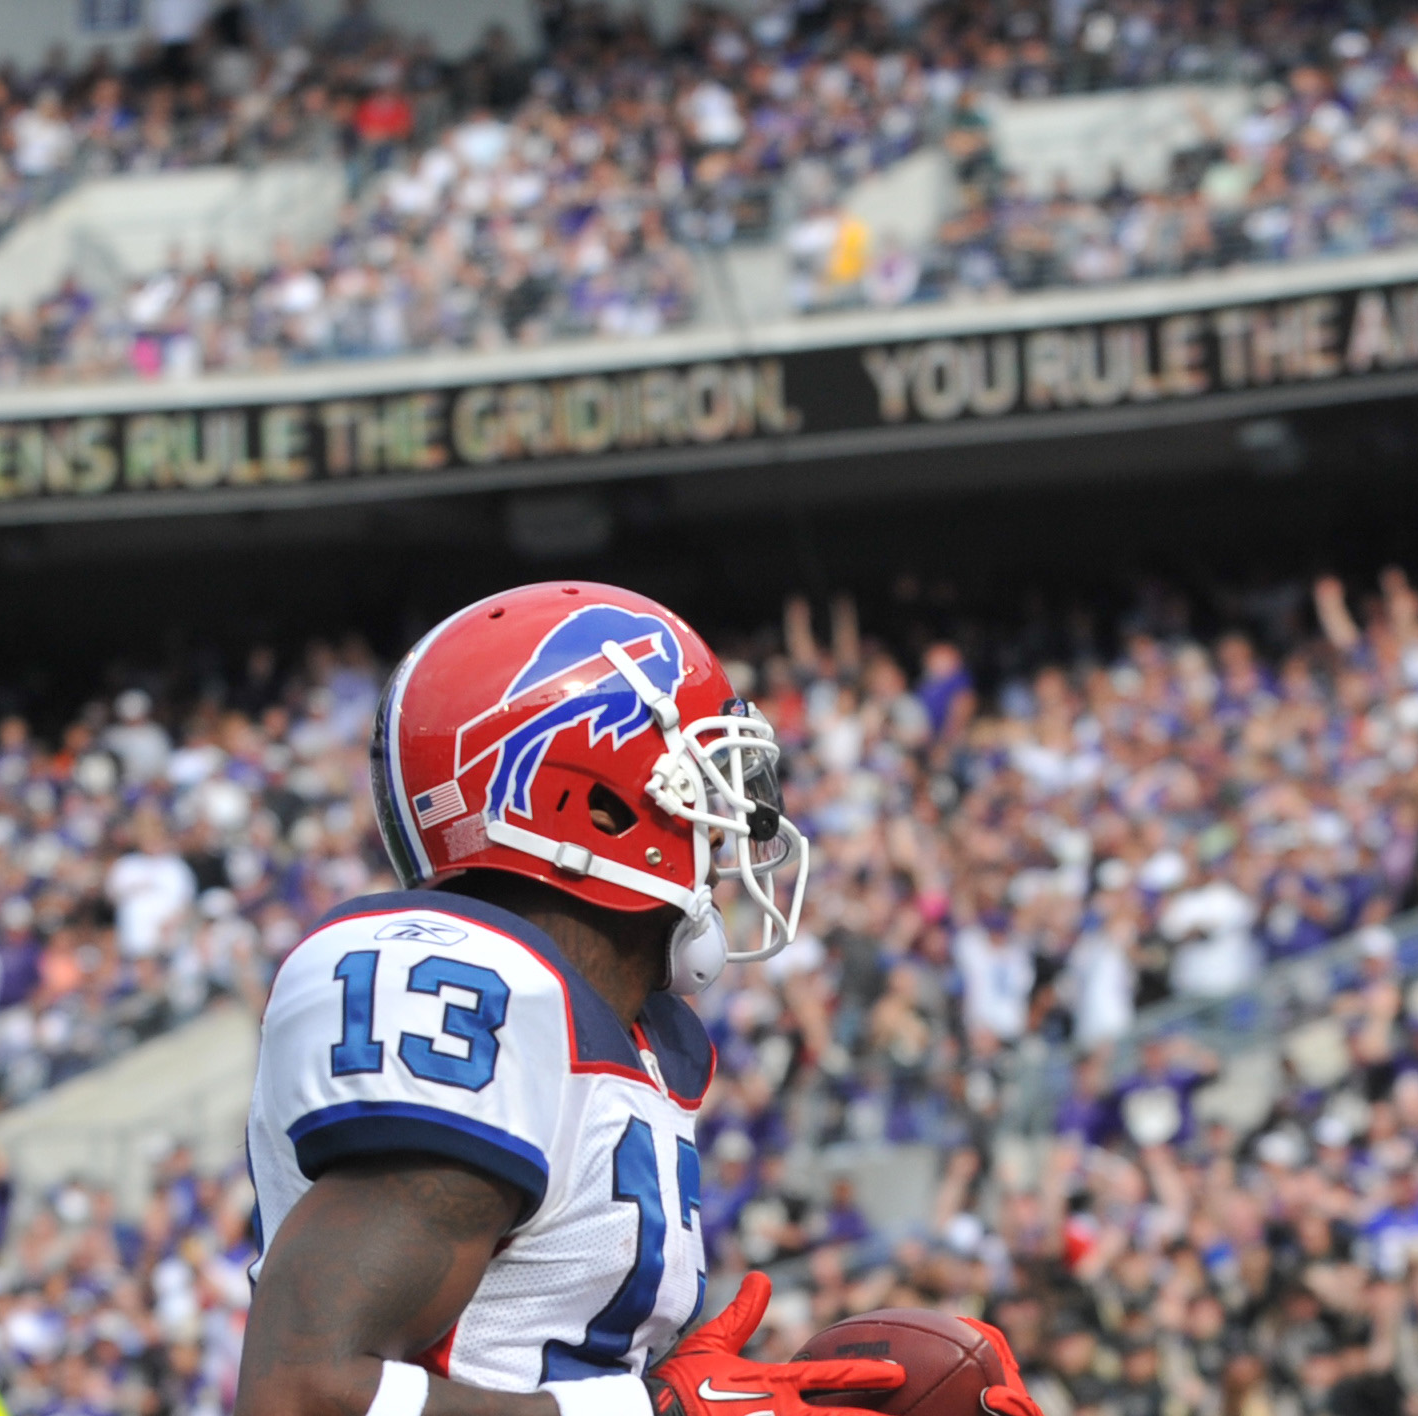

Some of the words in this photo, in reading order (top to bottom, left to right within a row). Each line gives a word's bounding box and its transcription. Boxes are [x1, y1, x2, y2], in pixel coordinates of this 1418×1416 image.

[861, 333, 1019, 420] YOU
[1024, 316, 1212, 410] RULE
[1216, 298, 1342, 387] THE
[124, 405, 311, 489] RULE
[322, 394, 449, 475] THE
[453, 361, 803, 464] GRIDIRON.
[331, 949, 511, 1092] 13
